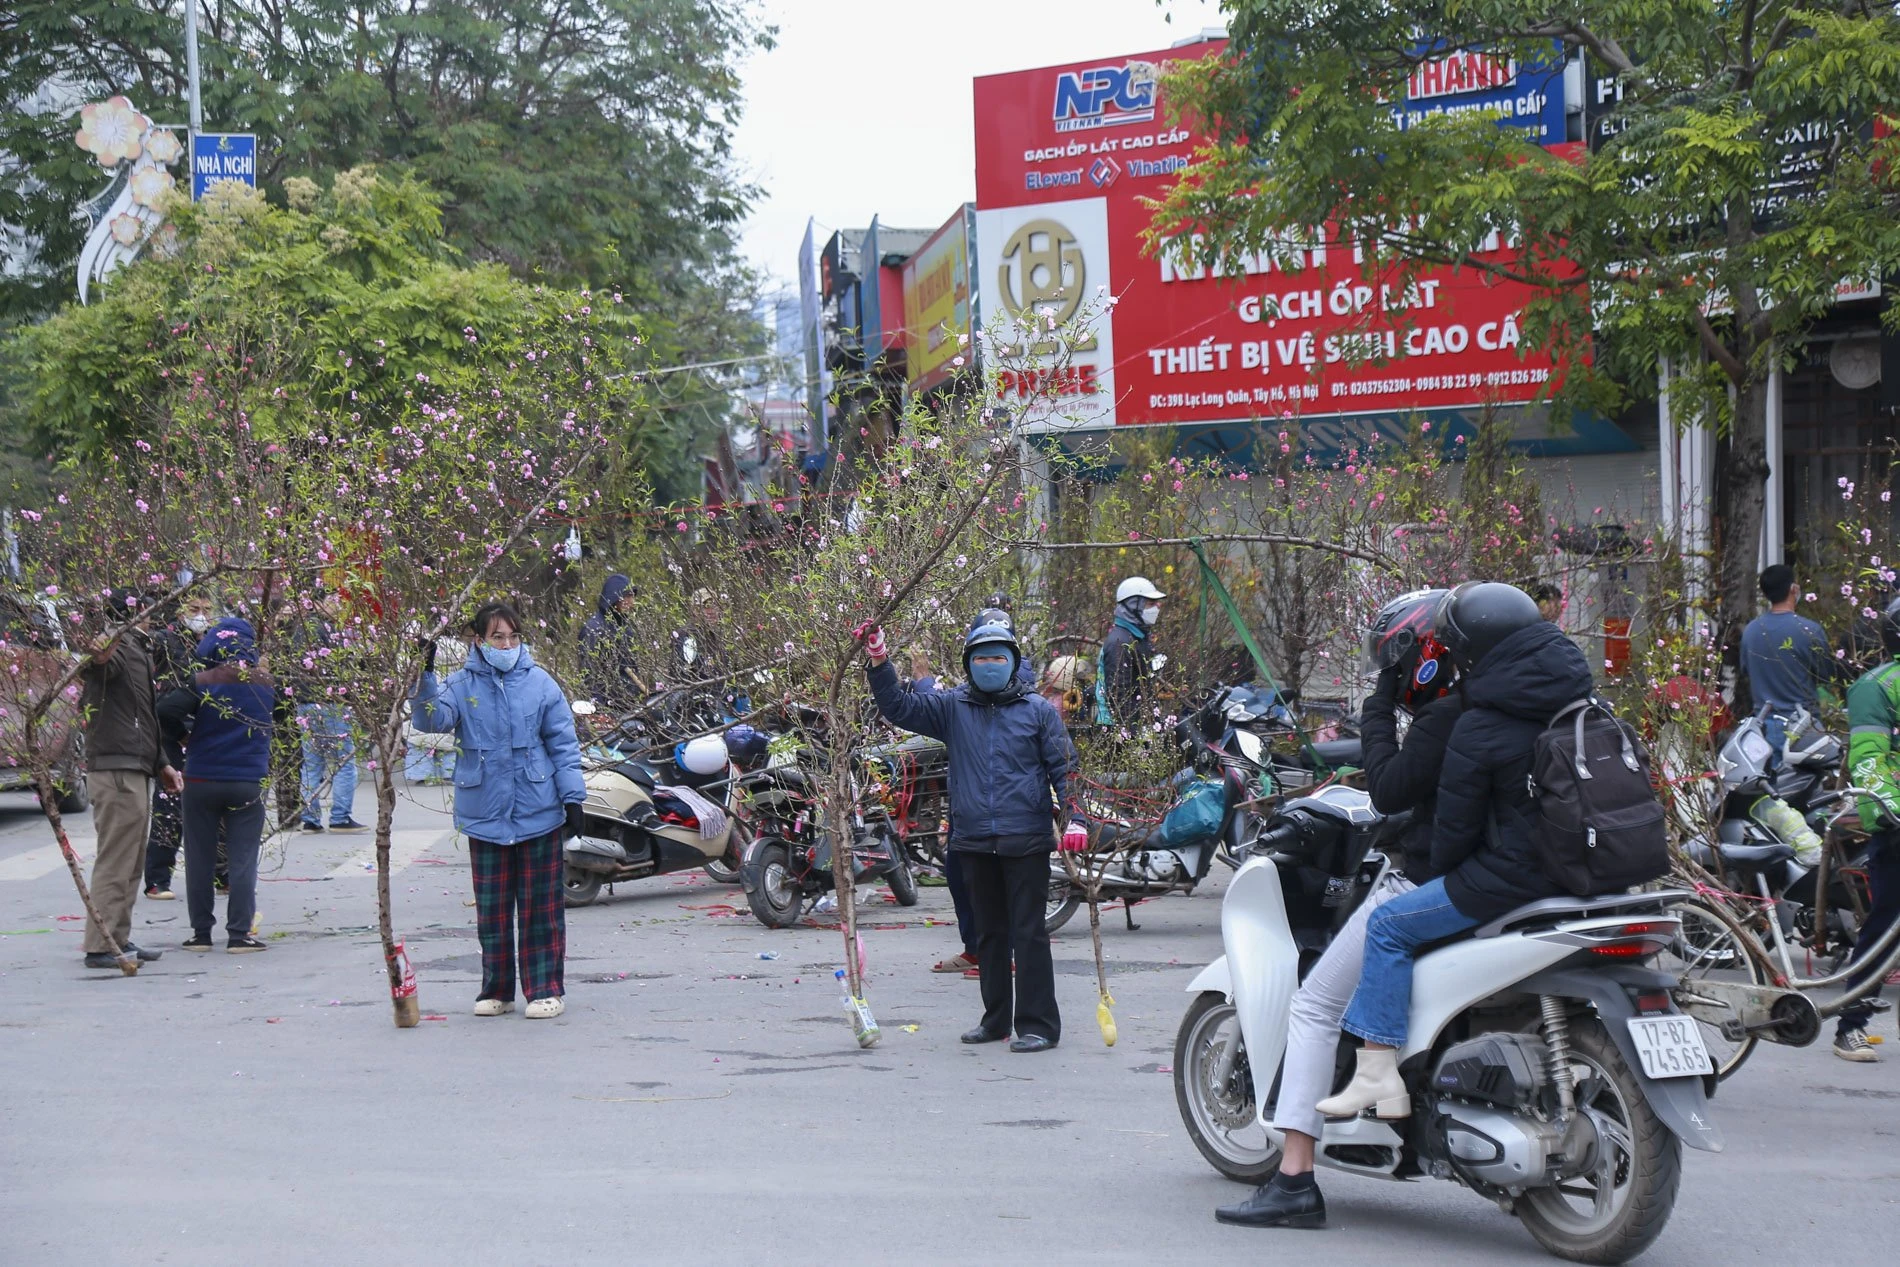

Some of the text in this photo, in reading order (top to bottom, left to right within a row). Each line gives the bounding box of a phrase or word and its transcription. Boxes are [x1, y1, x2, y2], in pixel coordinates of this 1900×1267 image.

[1057, 118, 1102, 132] VIETNAM
[1024, 126, 1190, 163] GẠCH ỐP LÁT CAO CẤP
[196, 151, 221, 175] NHÀ
[1239, 289, 1323, 329] GẠCH
[1329, 277, 1373, 316] ỐP
[1149, 335, 1233, 376] THIẾT
[1241, 340, 1271, 376] BỊ
[1276, 330, 1317, 374] VỆ
[1405, 323, 1469, 357] CAO
[1476, 309, 1532, 352] CẤ
[1185, 392, 1201, 409] Lạc
[1202, 391, 1224, 408] Long
[1226, 388, 1252, 405] Quân,
[1253, 387, 1269, 404] Tây
[1288, 385, 1302, 400] Hà
[1303, 383, 1319, 399] Nội
[1332, 383, 1348, 397] ĐT:
[1511, 369, 1529, 384] 826
[1530, 367, 1549, 383] 286
[1641, 1022, 1691, 1047] 17-B2
[1643, 1047, 1706, 1074] 745.65
